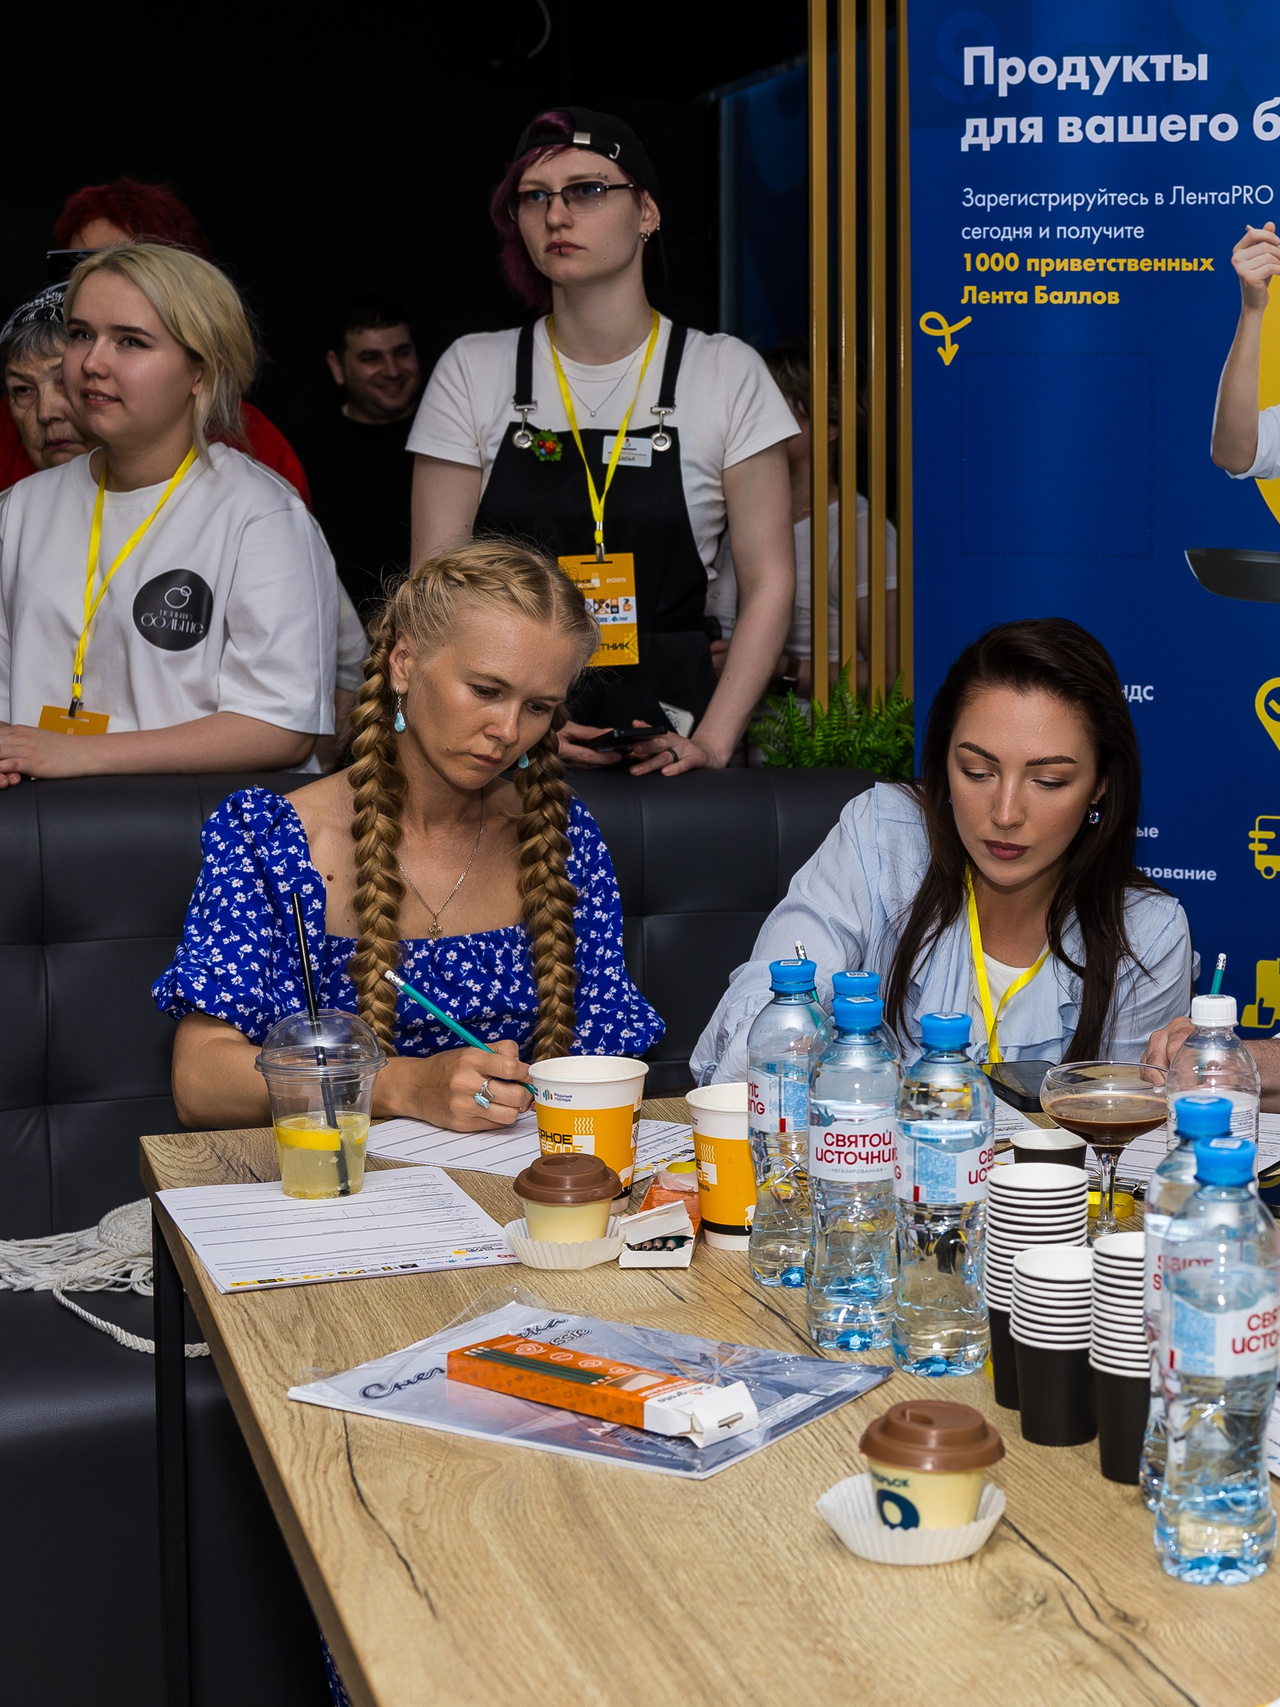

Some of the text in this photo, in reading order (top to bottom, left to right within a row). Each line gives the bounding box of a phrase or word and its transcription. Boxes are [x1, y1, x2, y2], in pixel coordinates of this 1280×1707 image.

[963, 46, 1208, 97] Продукты
[961, 116, 1043, 152] для
[1058, 113, 1239, 143] вашего
[962, 185, 1274, 212] Зарегистрируйтесь в ЛентаPRO
[961, 224, 1145, 244] сегодня и получите
[963, 253, 1215, 277] 1000 приветственных
[961, 285, 1120, 304] Лента Баллов
[823, 1129, 892, 1148] СВЯТОЙ
